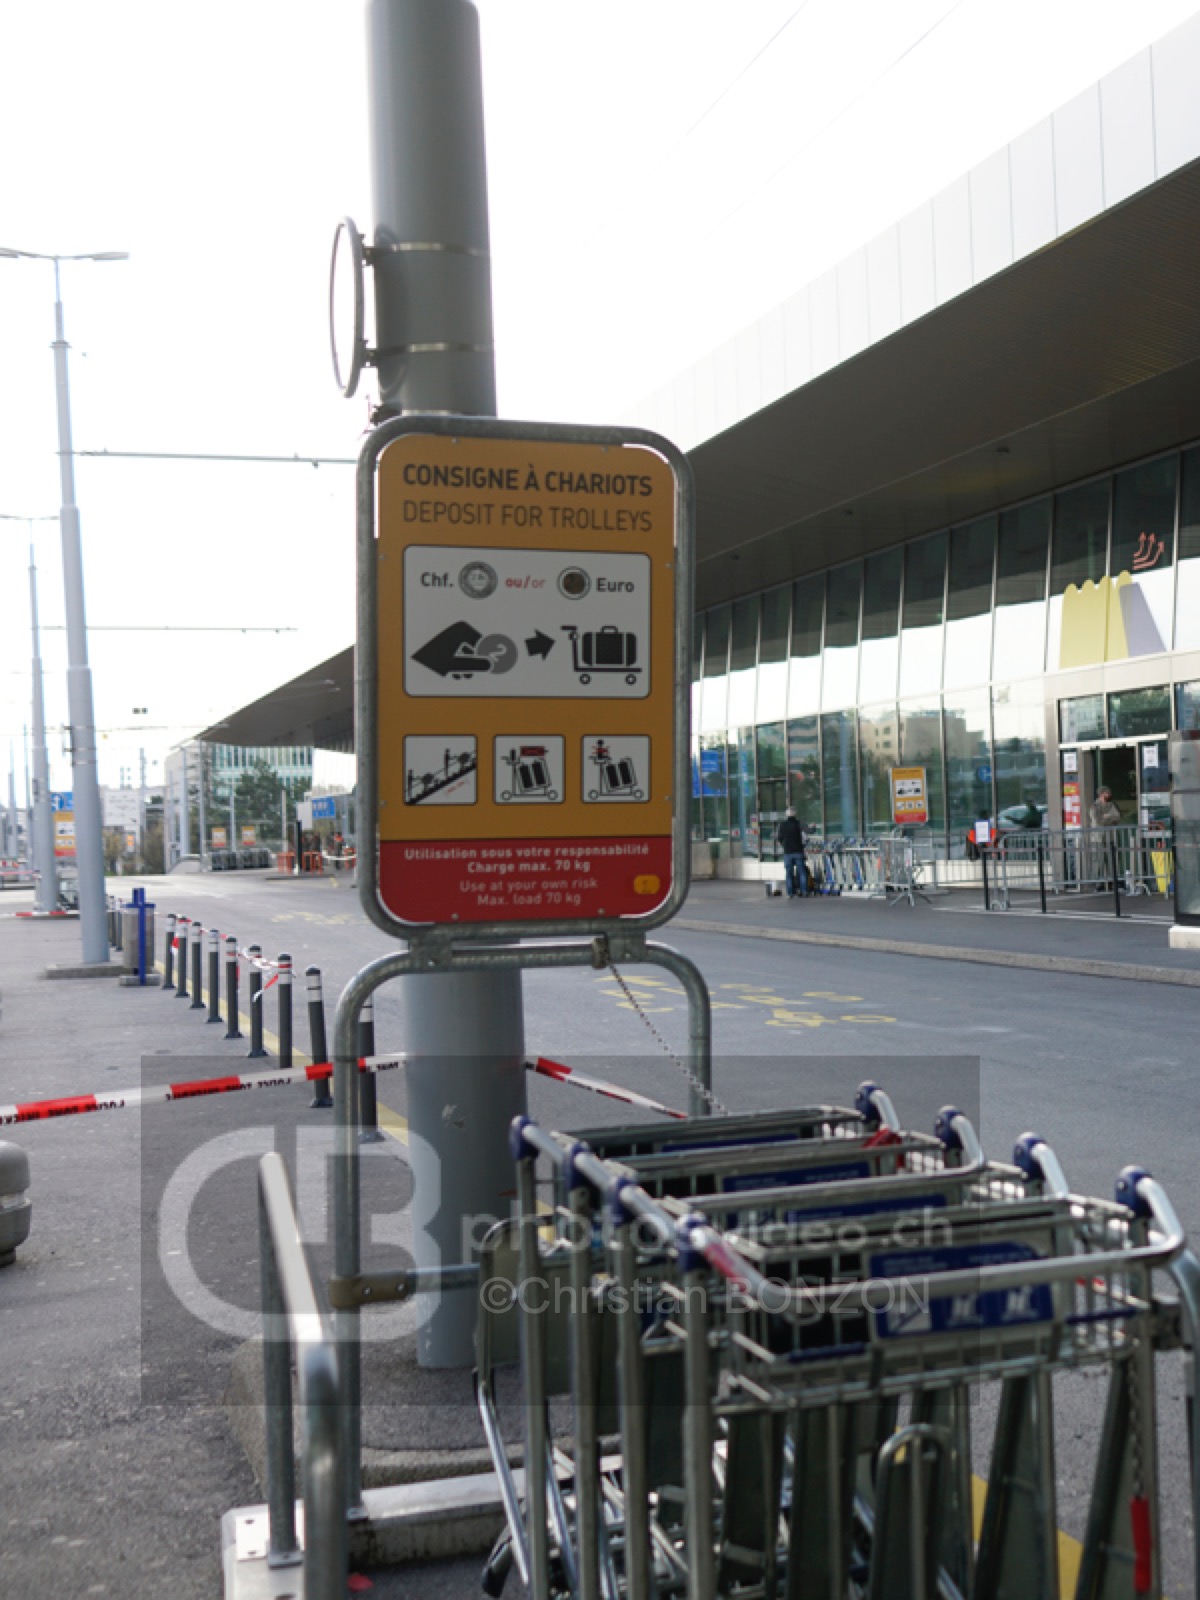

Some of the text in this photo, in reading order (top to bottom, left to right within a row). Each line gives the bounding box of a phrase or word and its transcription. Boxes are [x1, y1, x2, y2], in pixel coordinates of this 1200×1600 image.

[403, 463, 653, 496] CONSIGNE À CHARIOTS
[403, 500, 653, 532] DEPOSIT FOR TROLLEYS
[420, 571, 453, 588] Chf.
[596, 577, 635, 593] Euro
[404, 843, 649, 860] Utilisation sous votre responsabilité
[467, 859, 591, 874] Charge max. 70 kg
[459, 880, 486, 891] Use
[507, 881, 538, 893] your
[541, 880, 568, 889] own
[571, 877, 599, 889] risk
[513, 894, 543, 905] load
